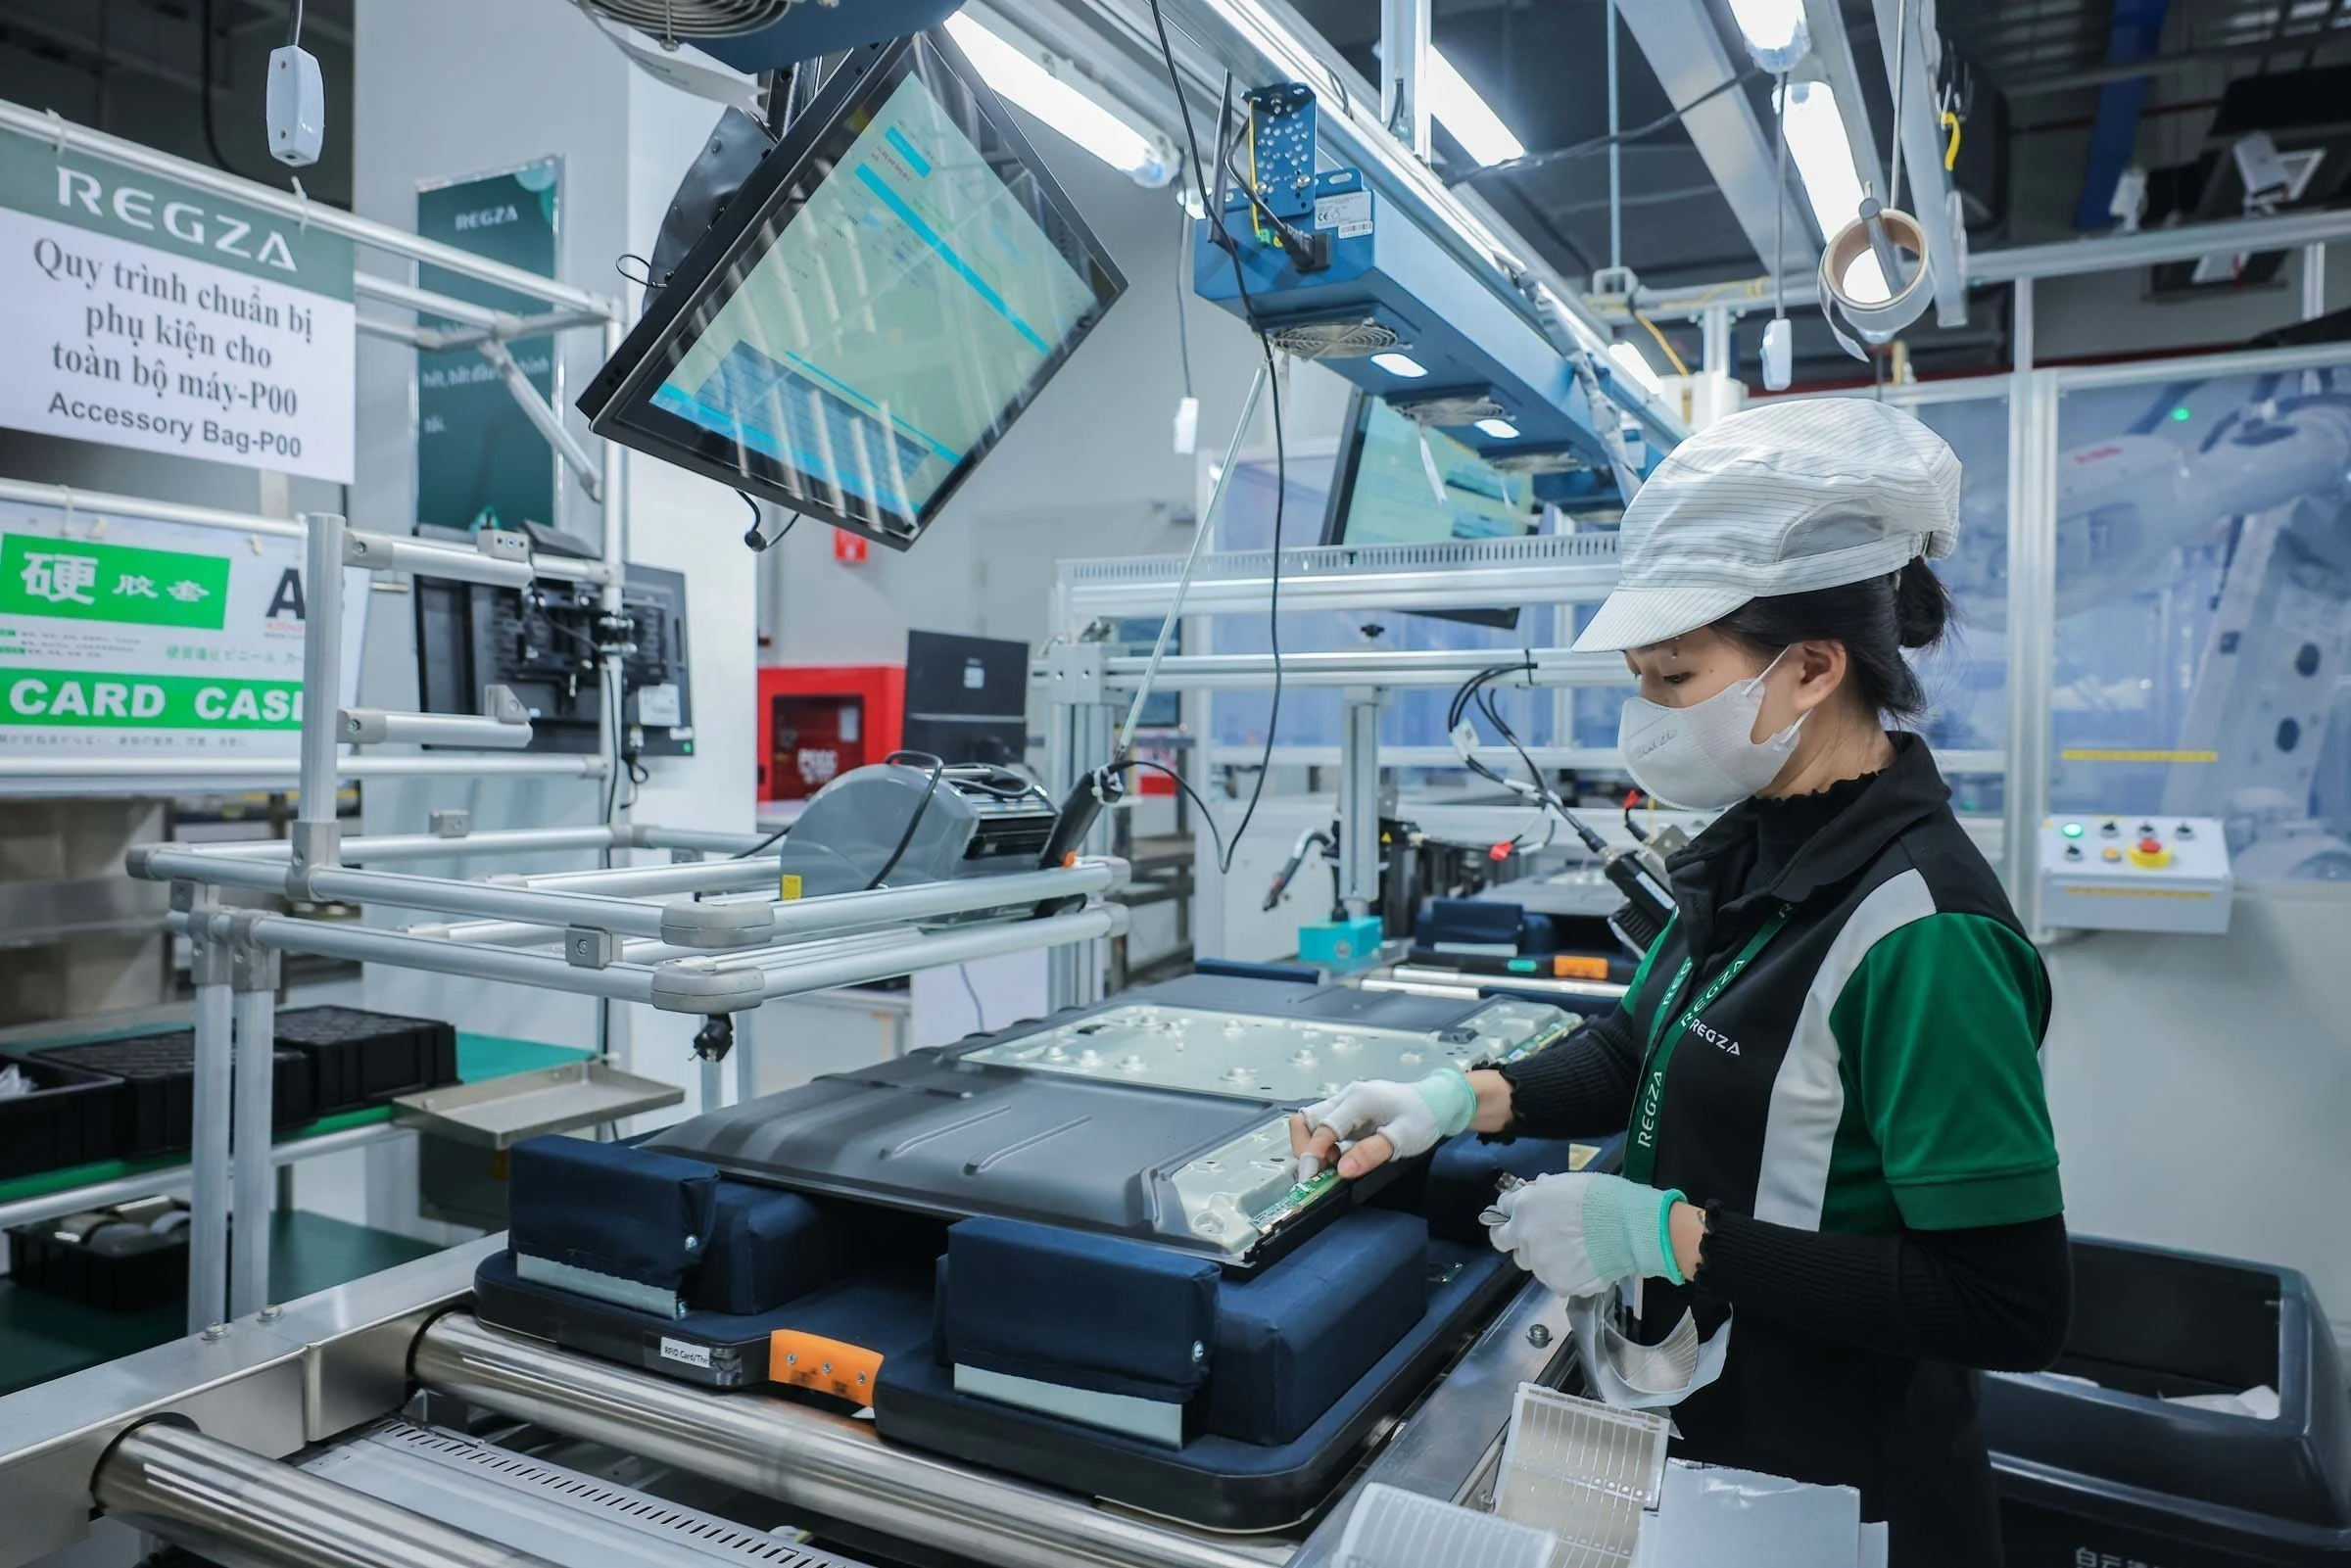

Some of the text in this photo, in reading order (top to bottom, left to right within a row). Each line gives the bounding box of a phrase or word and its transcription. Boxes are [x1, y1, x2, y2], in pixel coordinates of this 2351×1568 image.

[57, 166, 298, 272] REGZA
[33, 237, 312, 344] Quy trình chuẩn bị
[86, 301, 272, 369] phụ kiện cho
[53, 342, 298, 416] toàn bộ máy-P00
[48, 391, 302, 457] Accessory Bag-P00
[265, 567, 306, 620] A
[9, 678, 167, 718] CARD
[1680, 958, 1747, 1027] REGZA
[1689, 1018, 1741, 1057] REGZA
[1638, 1071, 1662, 1147] REGZA
